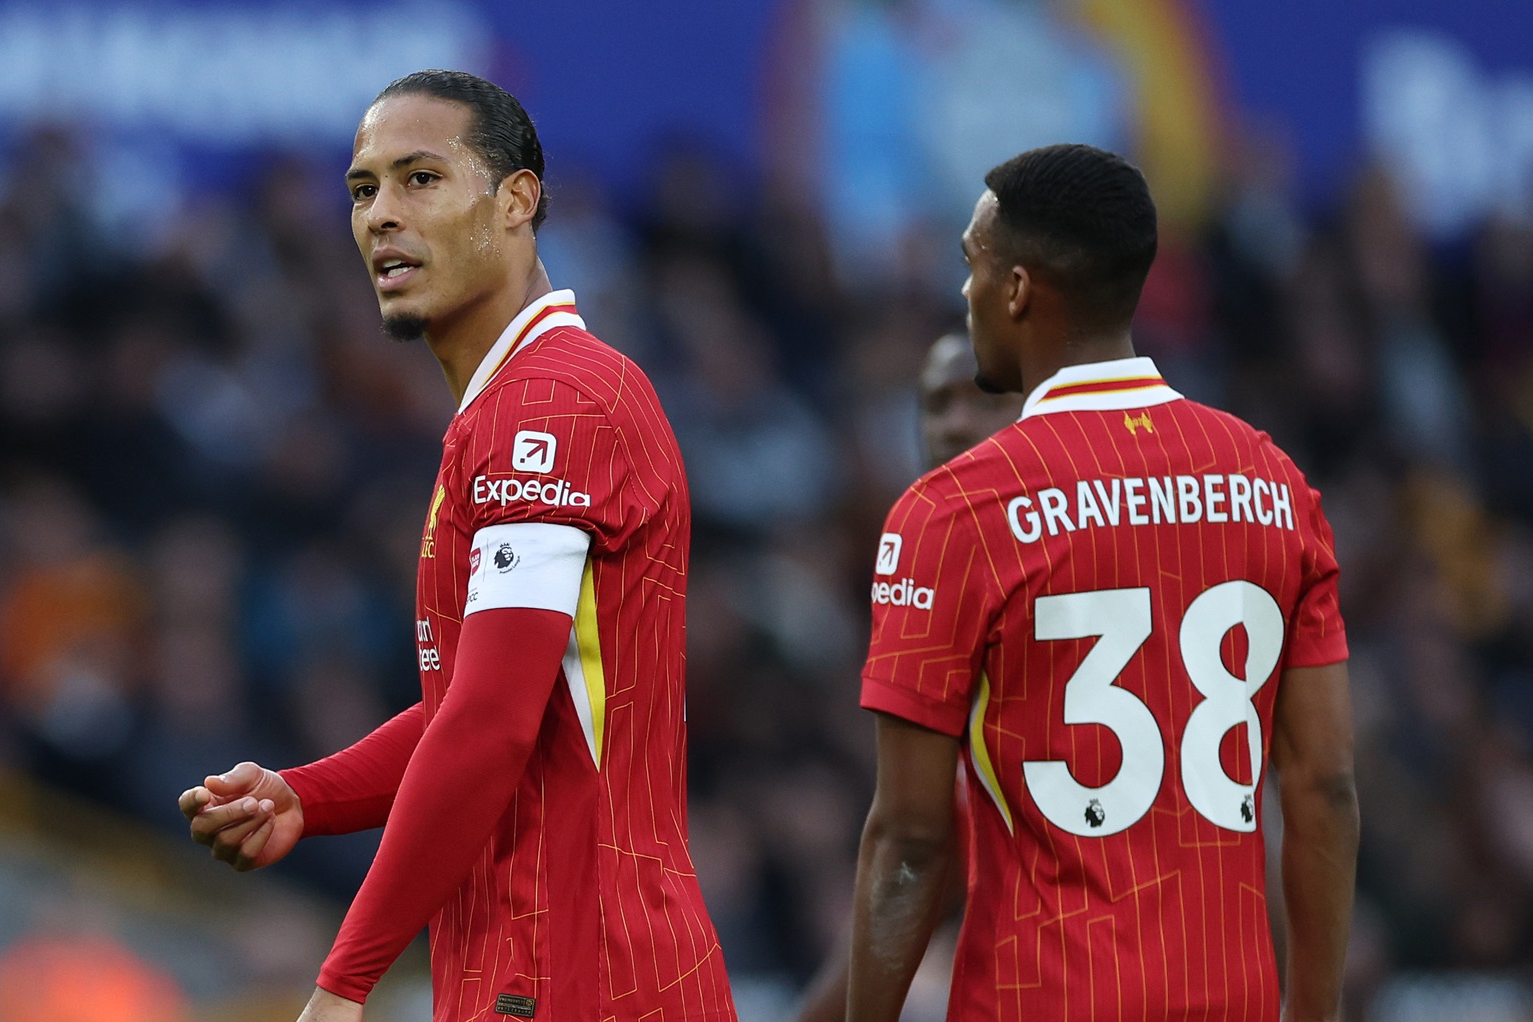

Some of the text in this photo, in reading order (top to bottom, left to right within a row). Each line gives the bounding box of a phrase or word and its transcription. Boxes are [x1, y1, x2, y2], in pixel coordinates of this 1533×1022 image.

[473, 475, 591, 507] Expedia
[1007, 474, 1294, 544] GRAVENBERCH
[1022, 579, 1285, 838] 38
